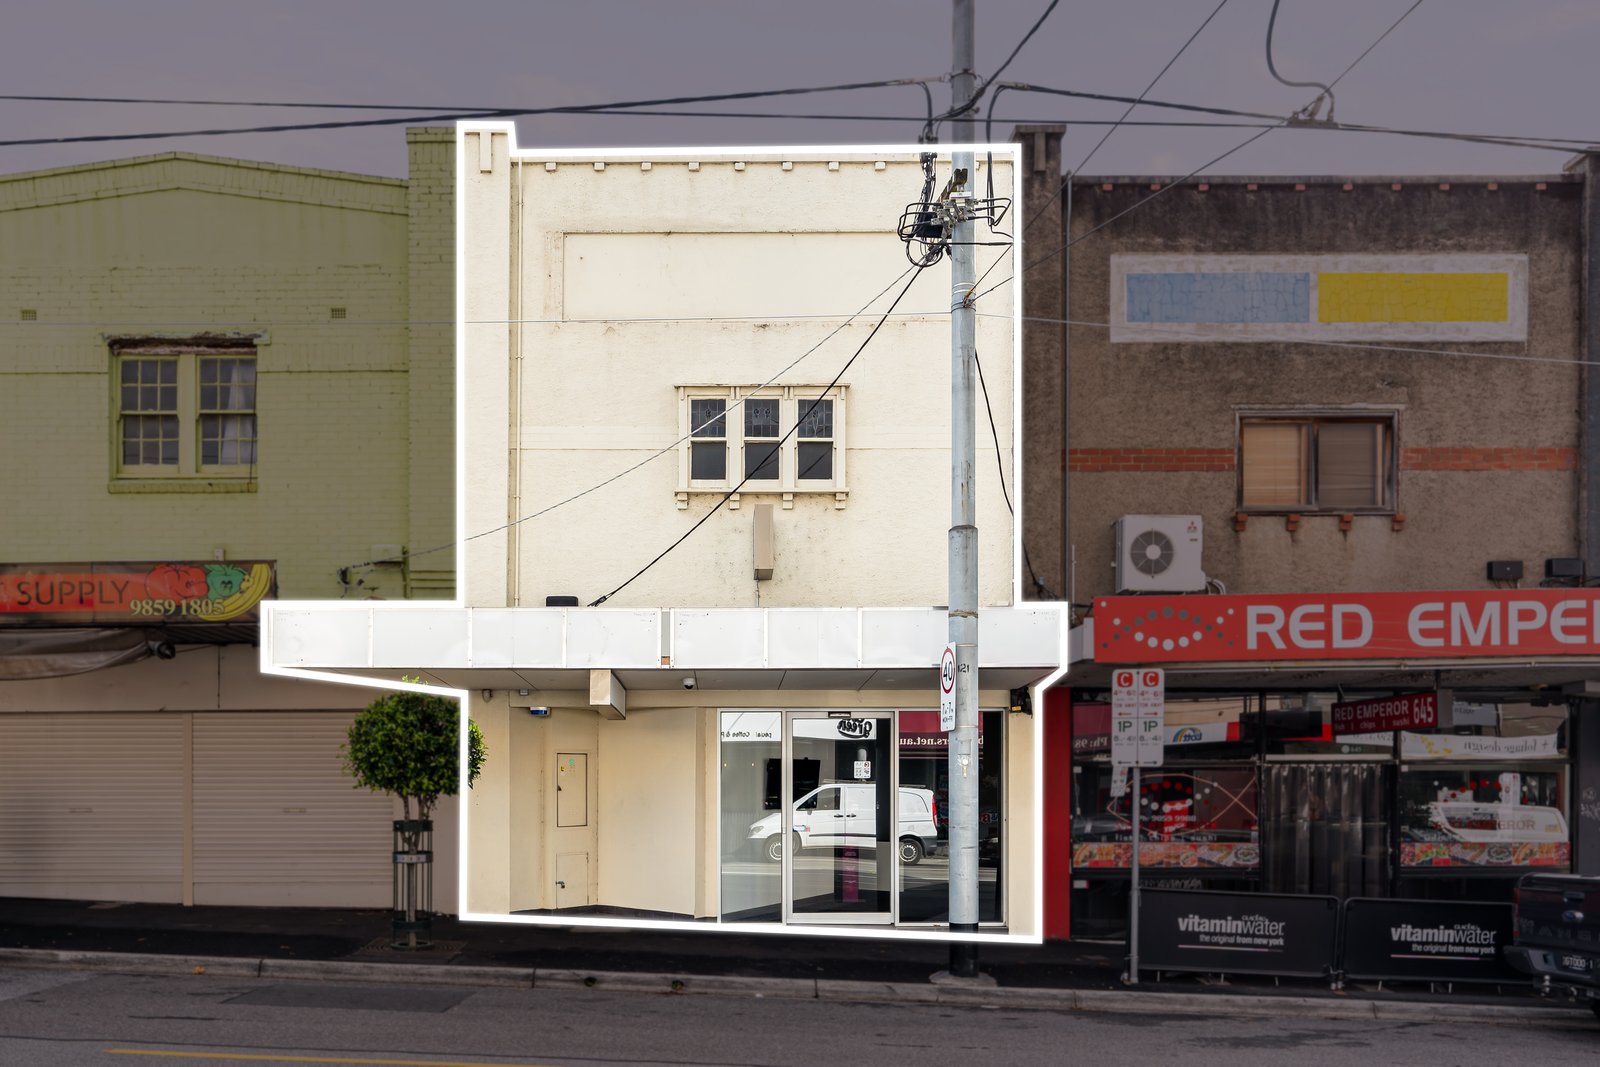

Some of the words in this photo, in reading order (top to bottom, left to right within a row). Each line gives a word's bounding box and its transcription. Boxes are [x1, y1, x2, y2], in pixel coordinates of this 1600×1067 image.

[17, 580, 129, 605] SUPPLY
[130, 599, 176, 616] 9859
[180, 599, 225, 615] 1805
[1247, 604, 1373, 650] RED
[1408, 599, 1600, 647] EMPE
[943, 661, 953, 681] 40
[1335, 707, 1354, 721] RED
[1357, 700, 1409, 719] EMPEROR
[1413, 697, 1434, 724] 645
[1118, 720, 1132, 733] 1P
[1143, 720, 1158, 733] 1P
[1360, 720, 1376, 730] chips
[1393, 718, 1410, 727] sushi
[1178, 914, 1285, 936] vitaminwater
[1391, 923, 1497, 945] vitaminwater
[1200, 934, 1211, 943] the
[1211, 935, 1235, 945] original
[1236, 935, 1253, 945] from
[1253, 937, 1268, 946] new
[1268, 938, 1285, 947] york
[1412, 943, 1423, 952] the
[1423, 943, 1447, 954] original
[1448, 944, 1465, 953] from
[1465, 945, 1480, 954] new
[1480, 946, 1496, 956] york
